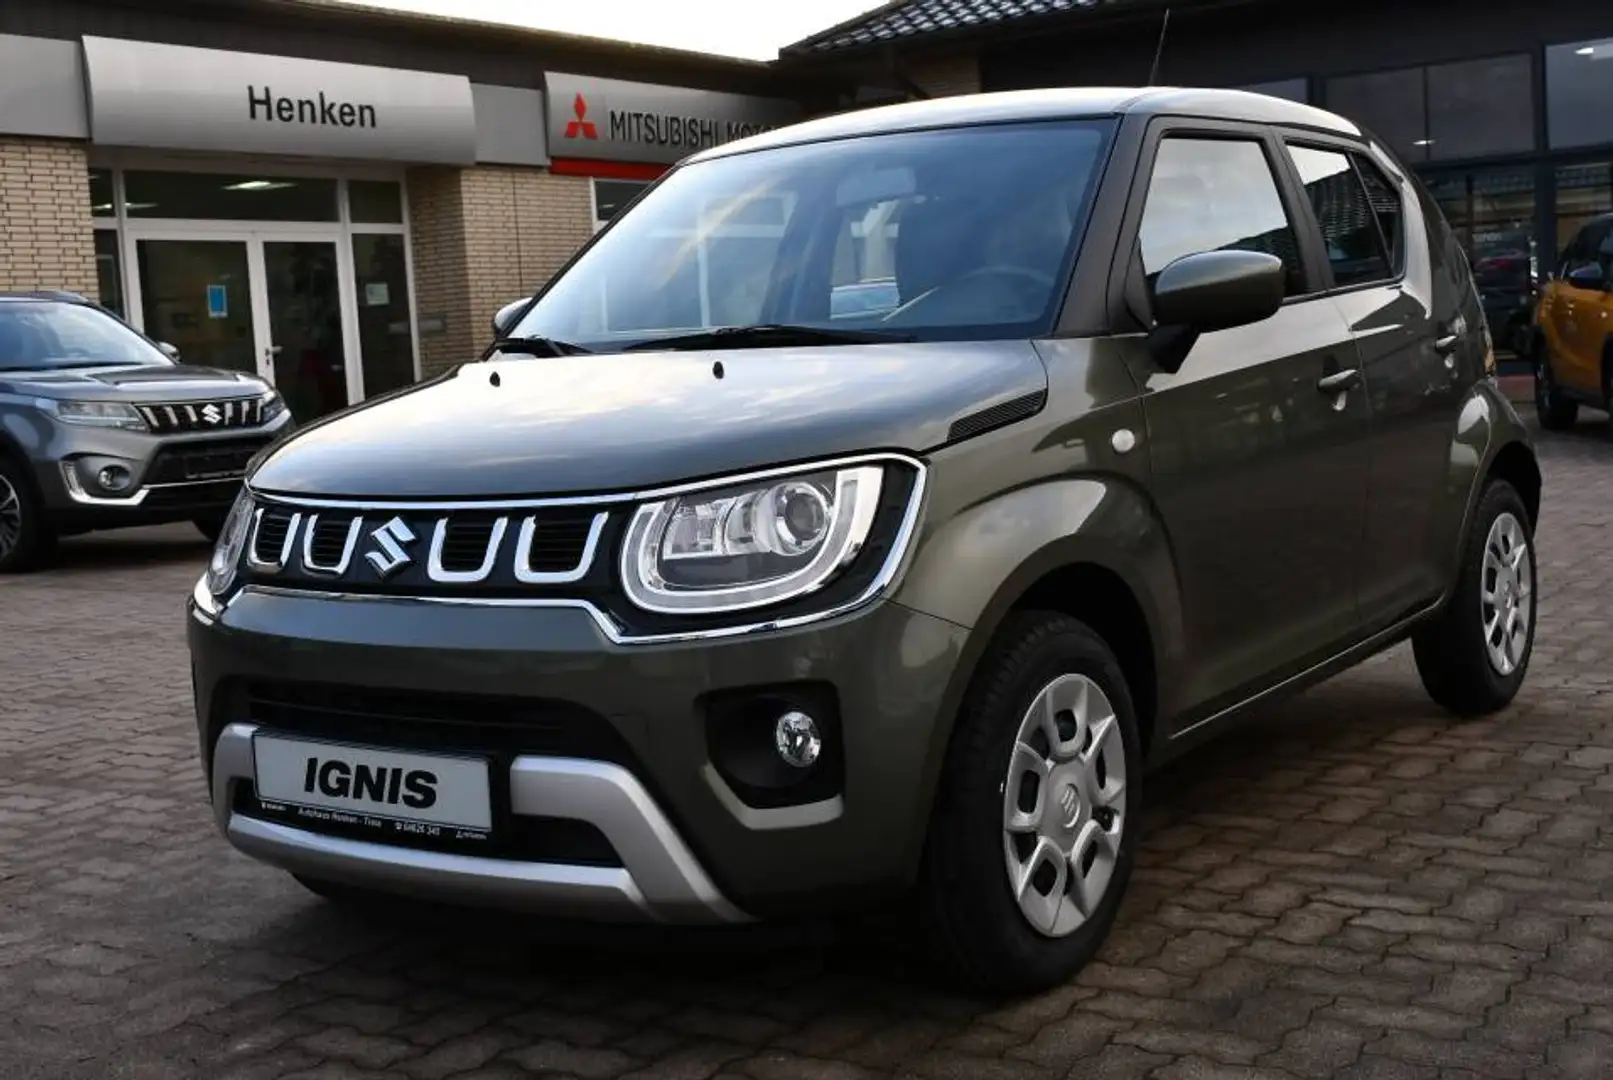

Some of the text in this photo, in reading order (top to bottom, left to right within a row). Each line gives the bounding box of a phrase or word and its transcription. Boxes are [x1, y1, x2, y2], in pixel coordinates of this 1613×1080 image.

[248, 85, 376, 128] Henken
[610, 110, 719, 148] MITSUBISHI
[304, 757, 438, 809] IGNIS
